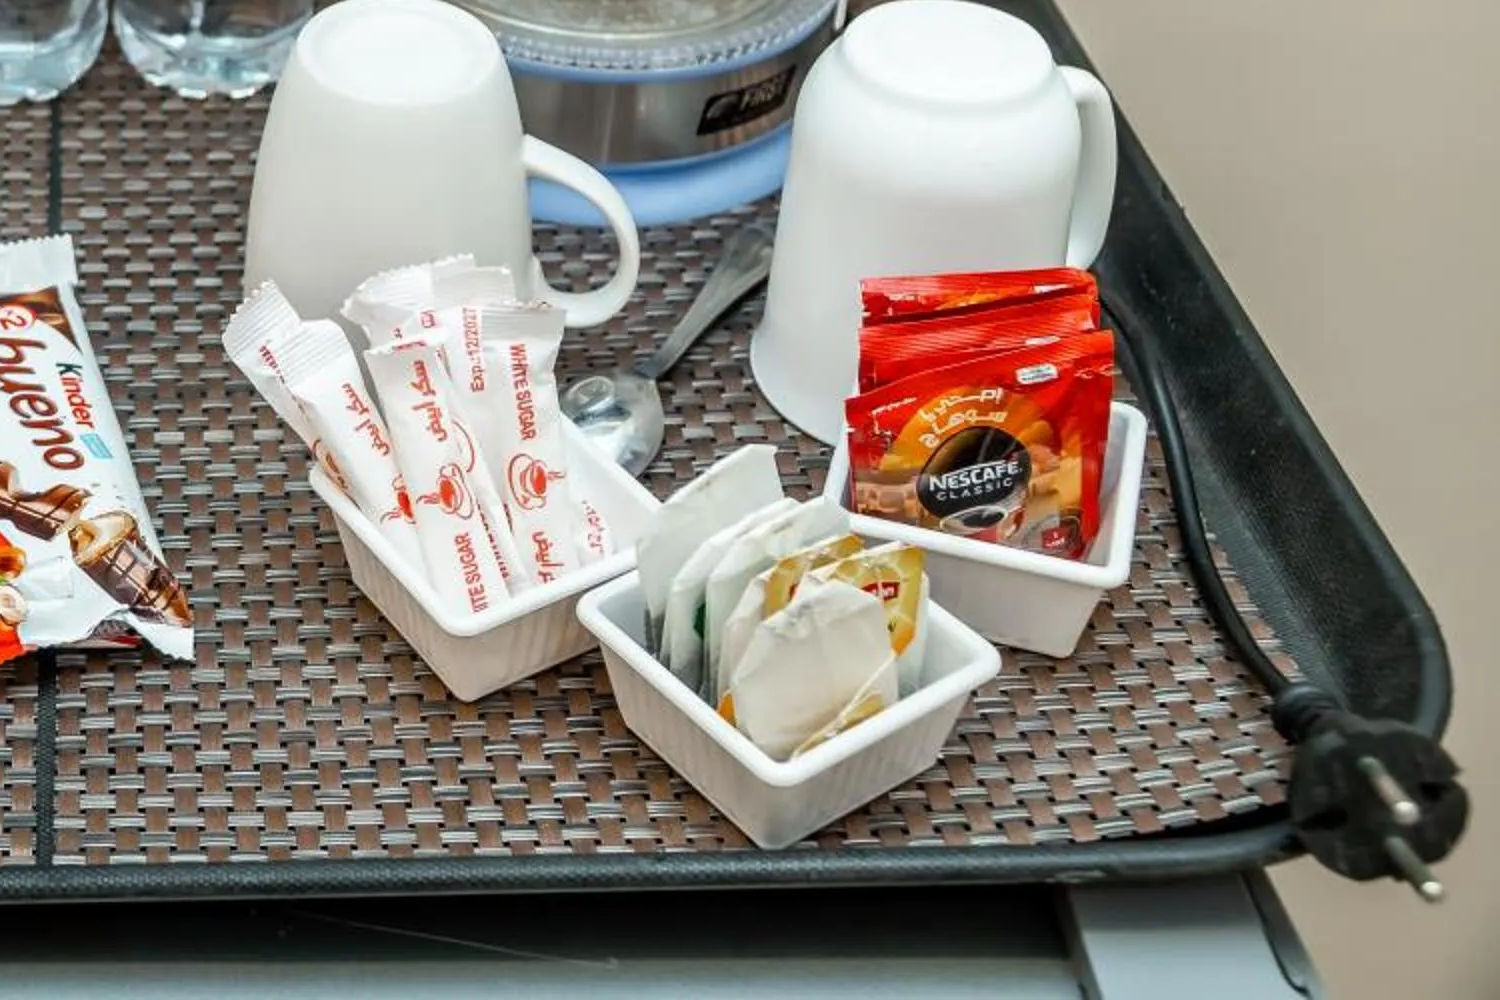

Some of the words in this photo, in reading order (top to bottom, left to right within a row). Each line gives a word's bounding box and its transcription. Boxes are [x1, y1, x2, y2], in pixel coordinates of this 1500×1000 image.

[510, 343, 530, 390] WHITE
[516, 390, 537, 441] SUGAR
[936, 477, 1013, 501] CLASSIC
[454, 531, 483, 584] SUGAR
